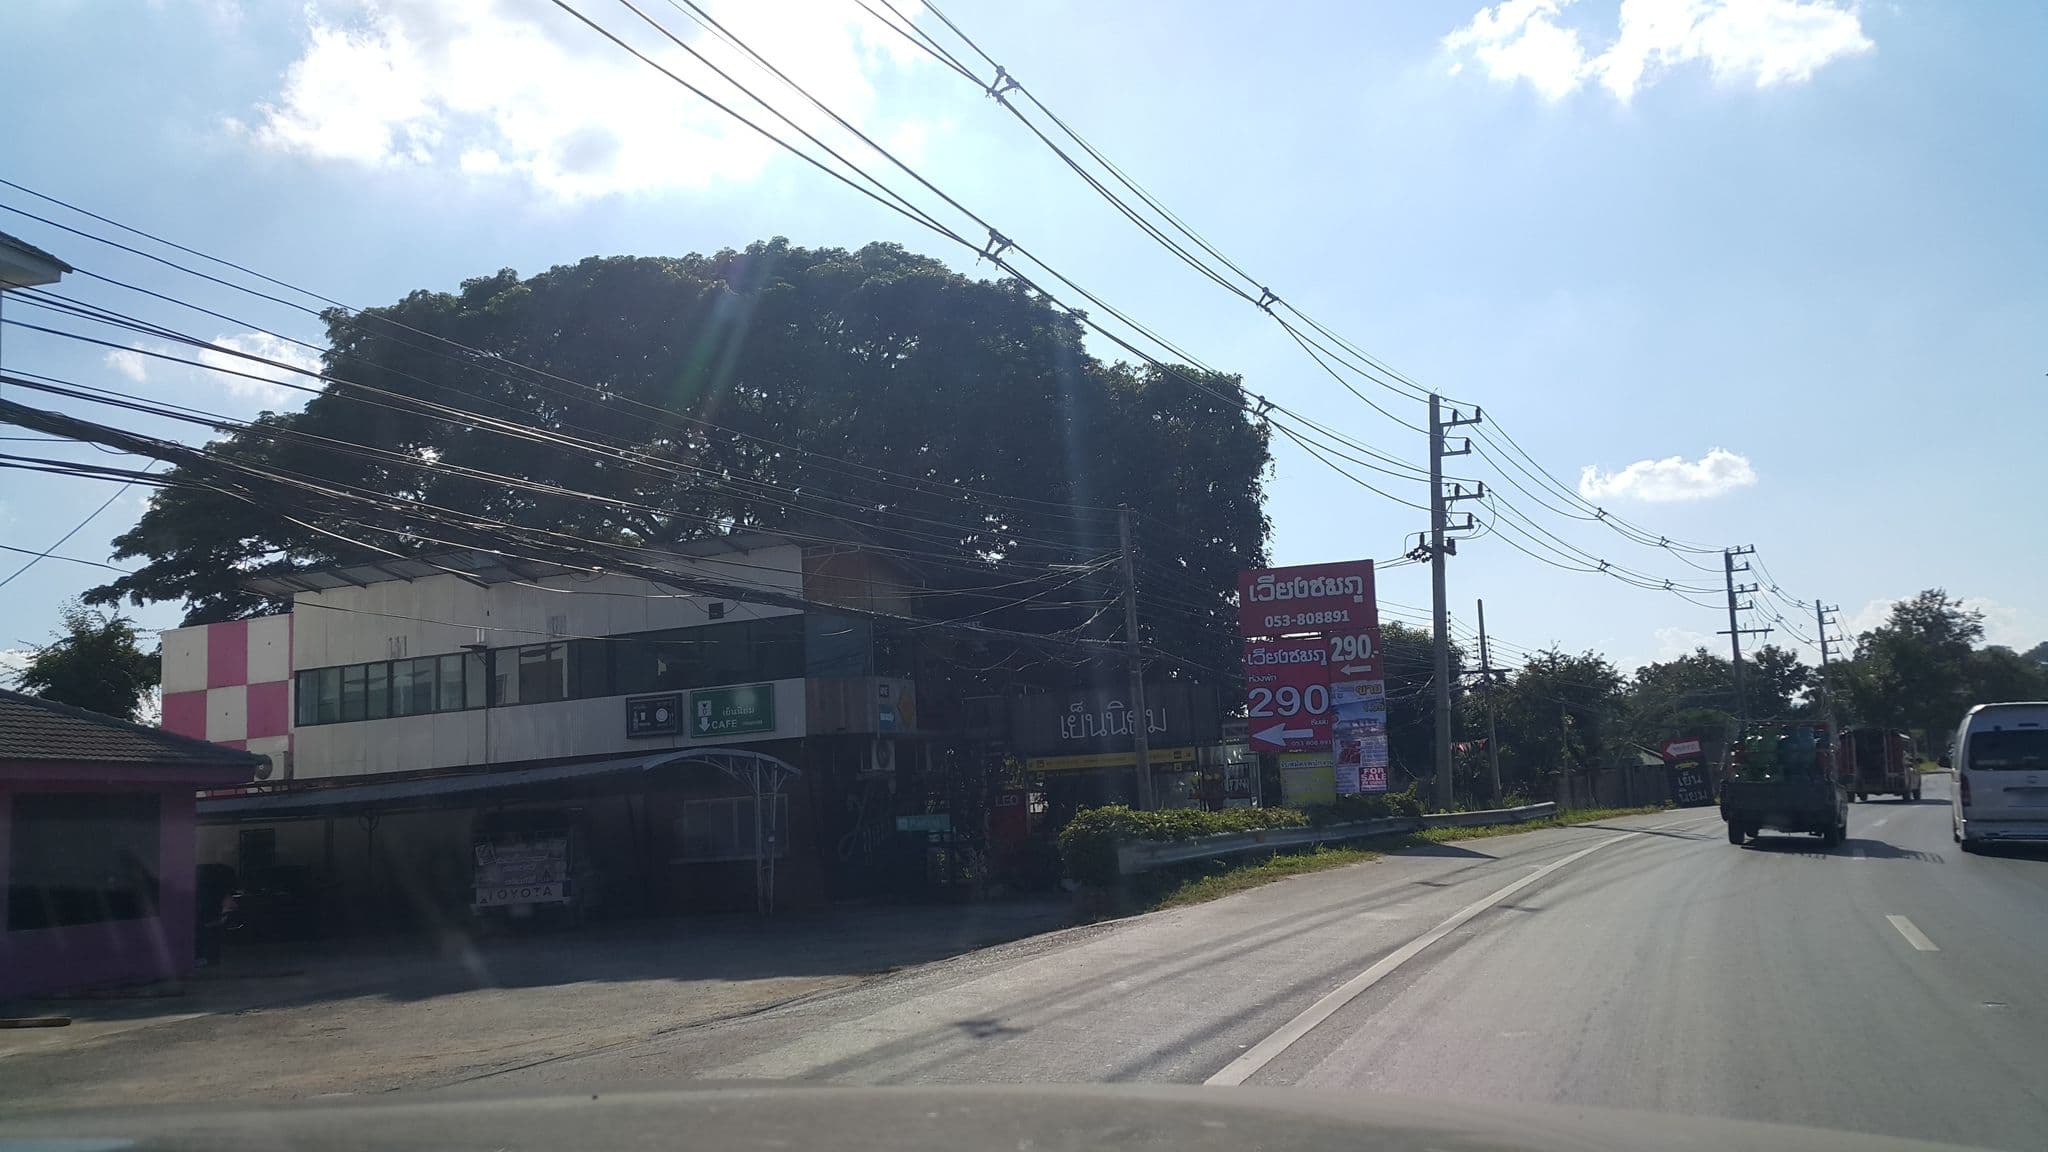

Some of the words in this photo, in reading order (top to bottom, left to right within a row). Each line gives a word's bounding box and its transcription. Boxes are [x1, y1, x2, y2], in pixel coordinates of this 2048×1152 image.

[1249, 574, 1363, 603] เวียงชมภู
[1265, 610, 1350, 627] 053-808891
[1248, 684, 1330, 718] 290
[711, 719, 737, 730] CAFE
[1361, 773, 1387, 781] SALE
[488, 886, 553, 901] TOYOTA
